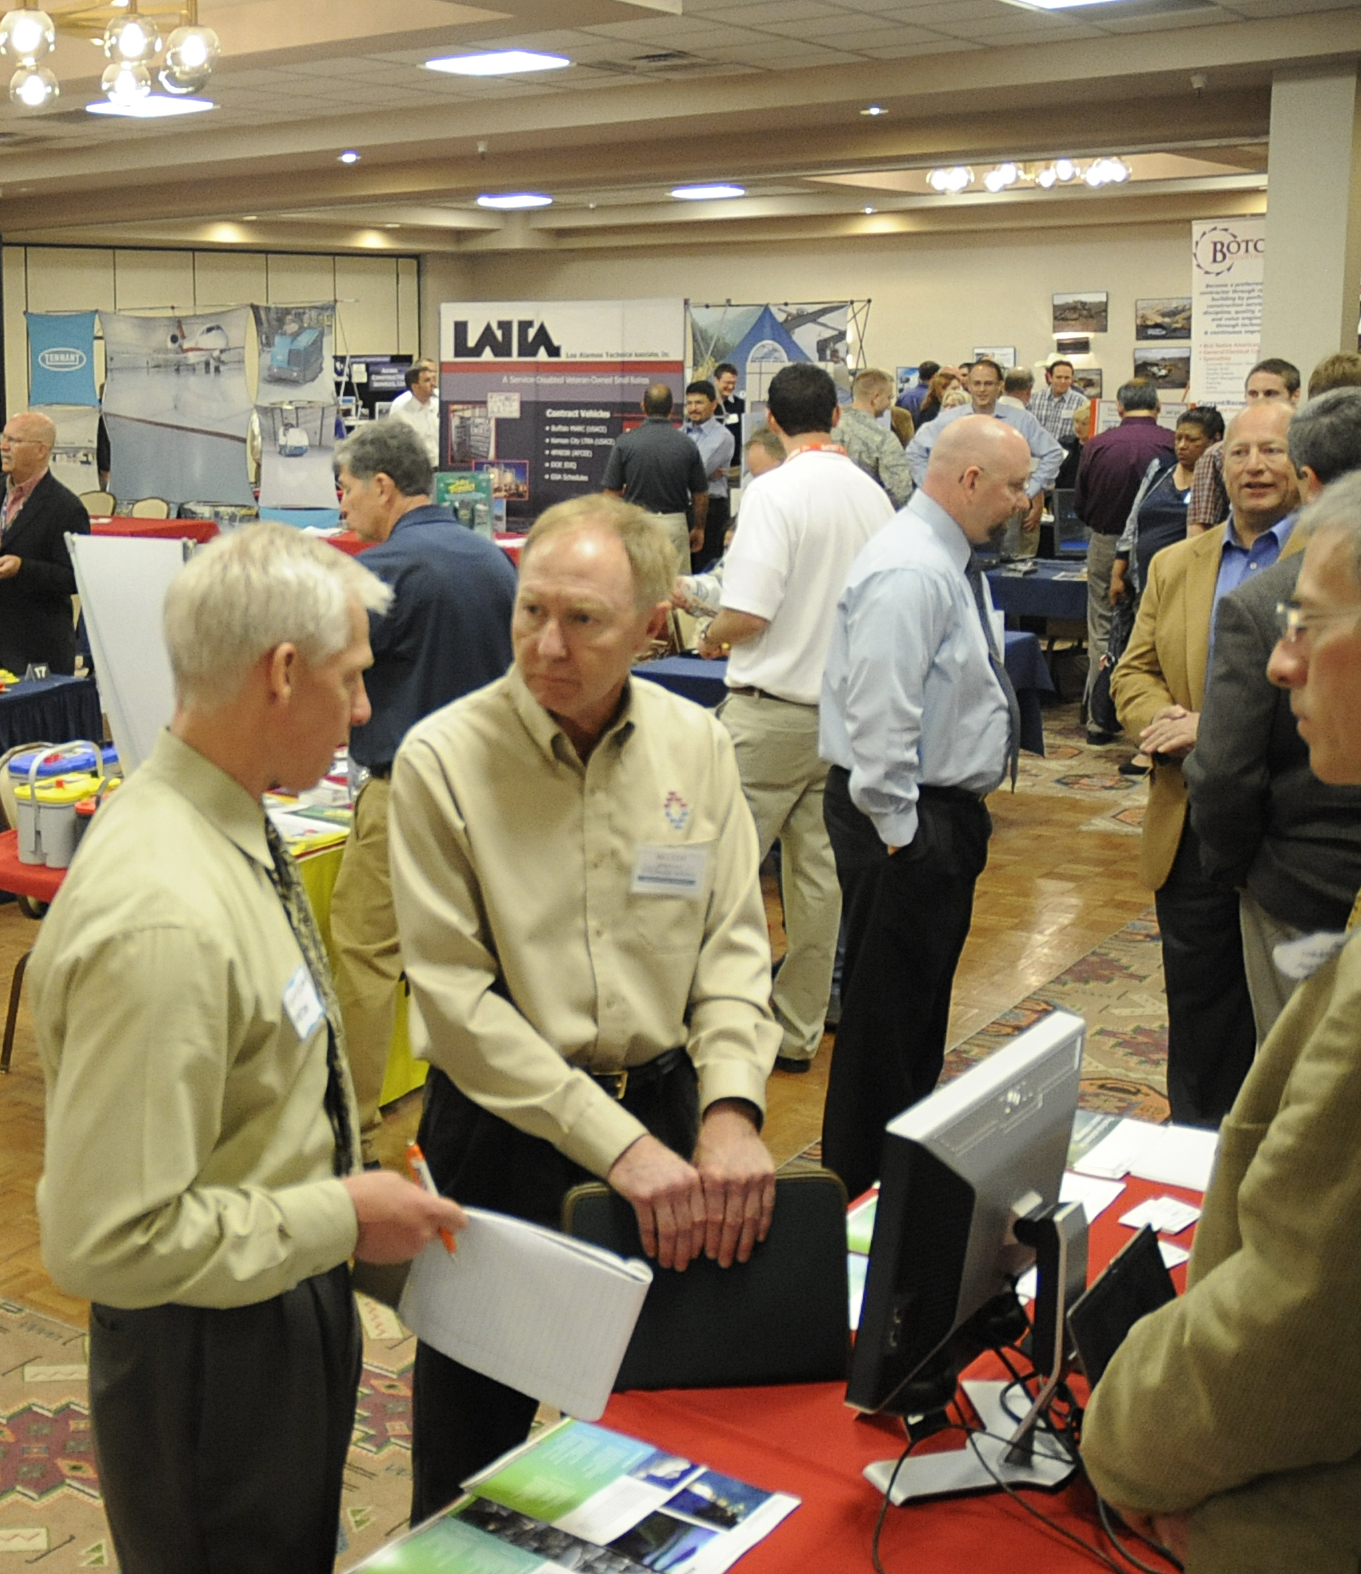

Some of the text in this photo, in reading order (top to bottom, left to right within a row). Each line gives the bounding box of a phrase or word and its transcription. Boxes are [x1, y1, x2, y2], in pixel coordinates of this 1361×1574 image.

[454, 320, 561, 358] LATA
[546, 409, 611, 419] Contract Vehicles
[34, 666, 46, 679] 17
